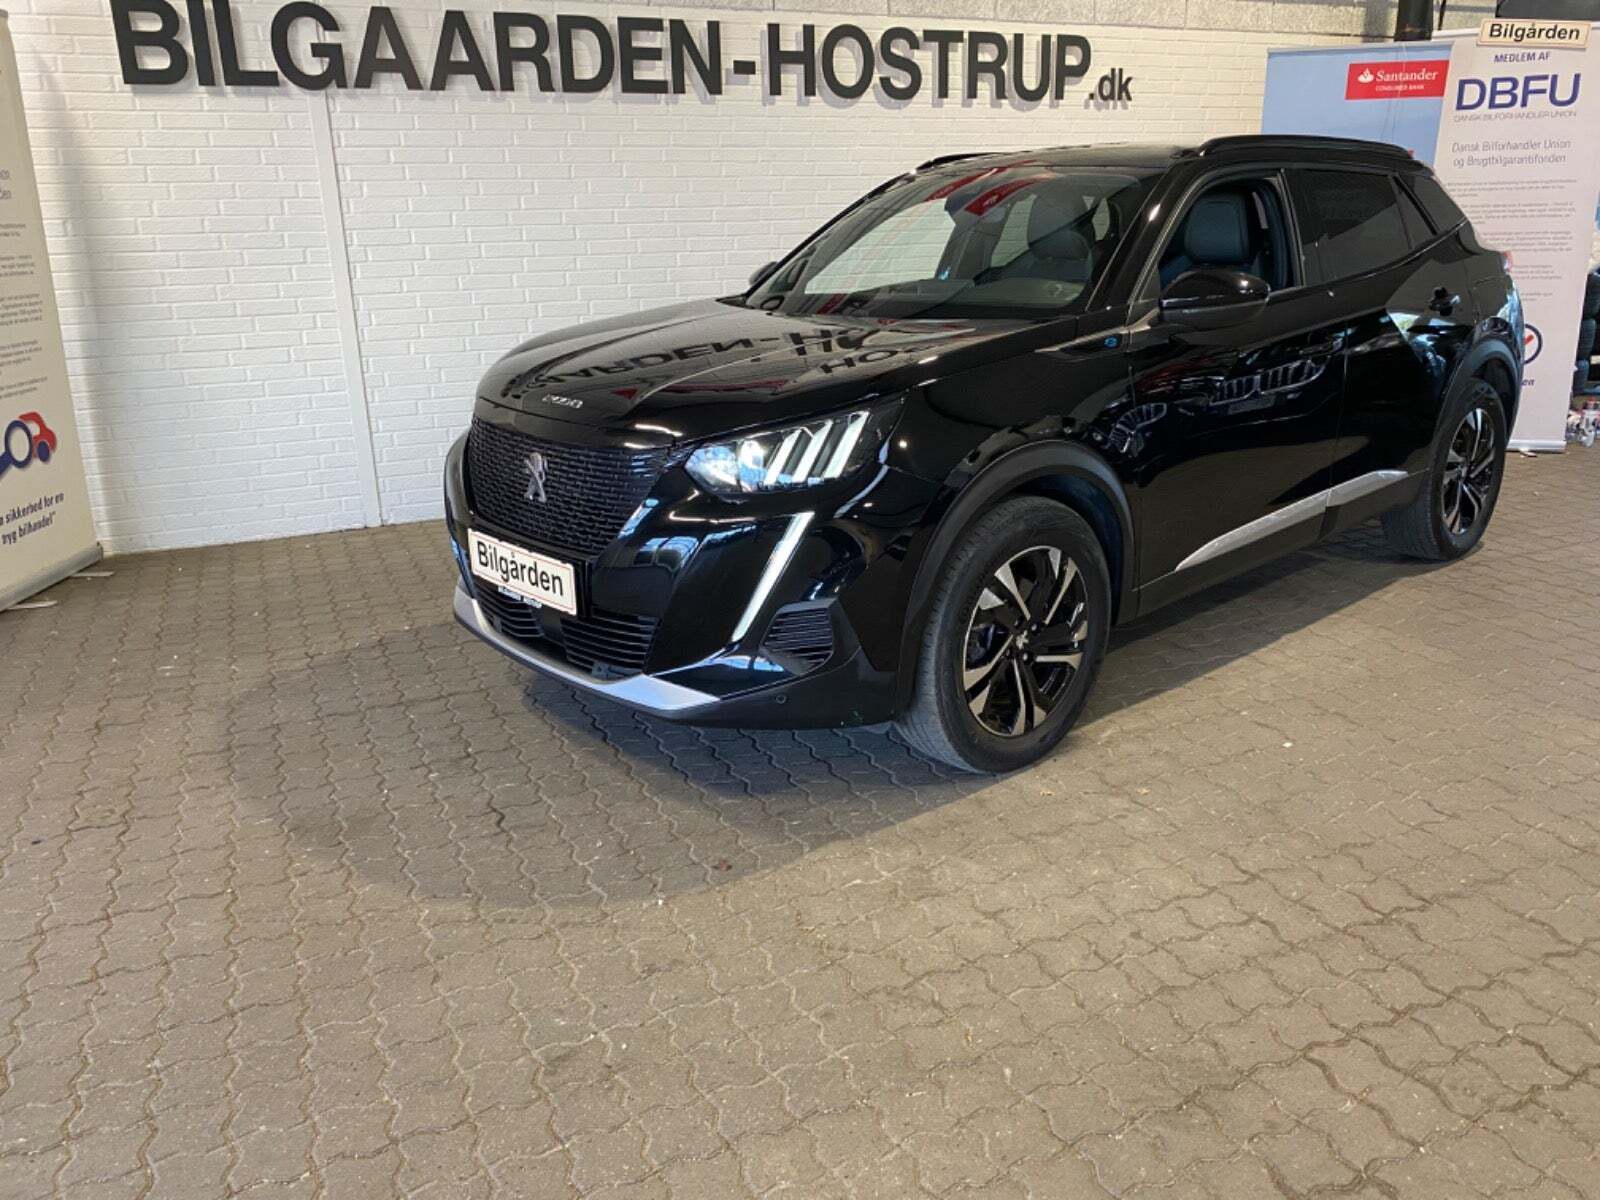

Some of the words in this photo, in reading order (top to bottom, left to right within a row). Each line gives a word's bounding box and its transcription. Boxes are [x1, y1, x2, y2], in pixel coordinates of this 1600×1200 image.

[1488, 22, 1580, 42] Bilgården
[1493, 52, 1536, 63] MEDLEM
[1537, 51, 1550, 61] AF
[1375, 68, 1439, 82] Santander
[1455, 73, 1582, 111] DBFU
[1451, 141, 1480, 153] Dansk
[1481, 140, 1541, 152] Bilforhandler
[1543, 139, 1571, 150] Union
[1453, 158, 1465, 168] og
[5, 497, 43, 524] sikkerhed
[476, 541, 564, 597] Bilgården
